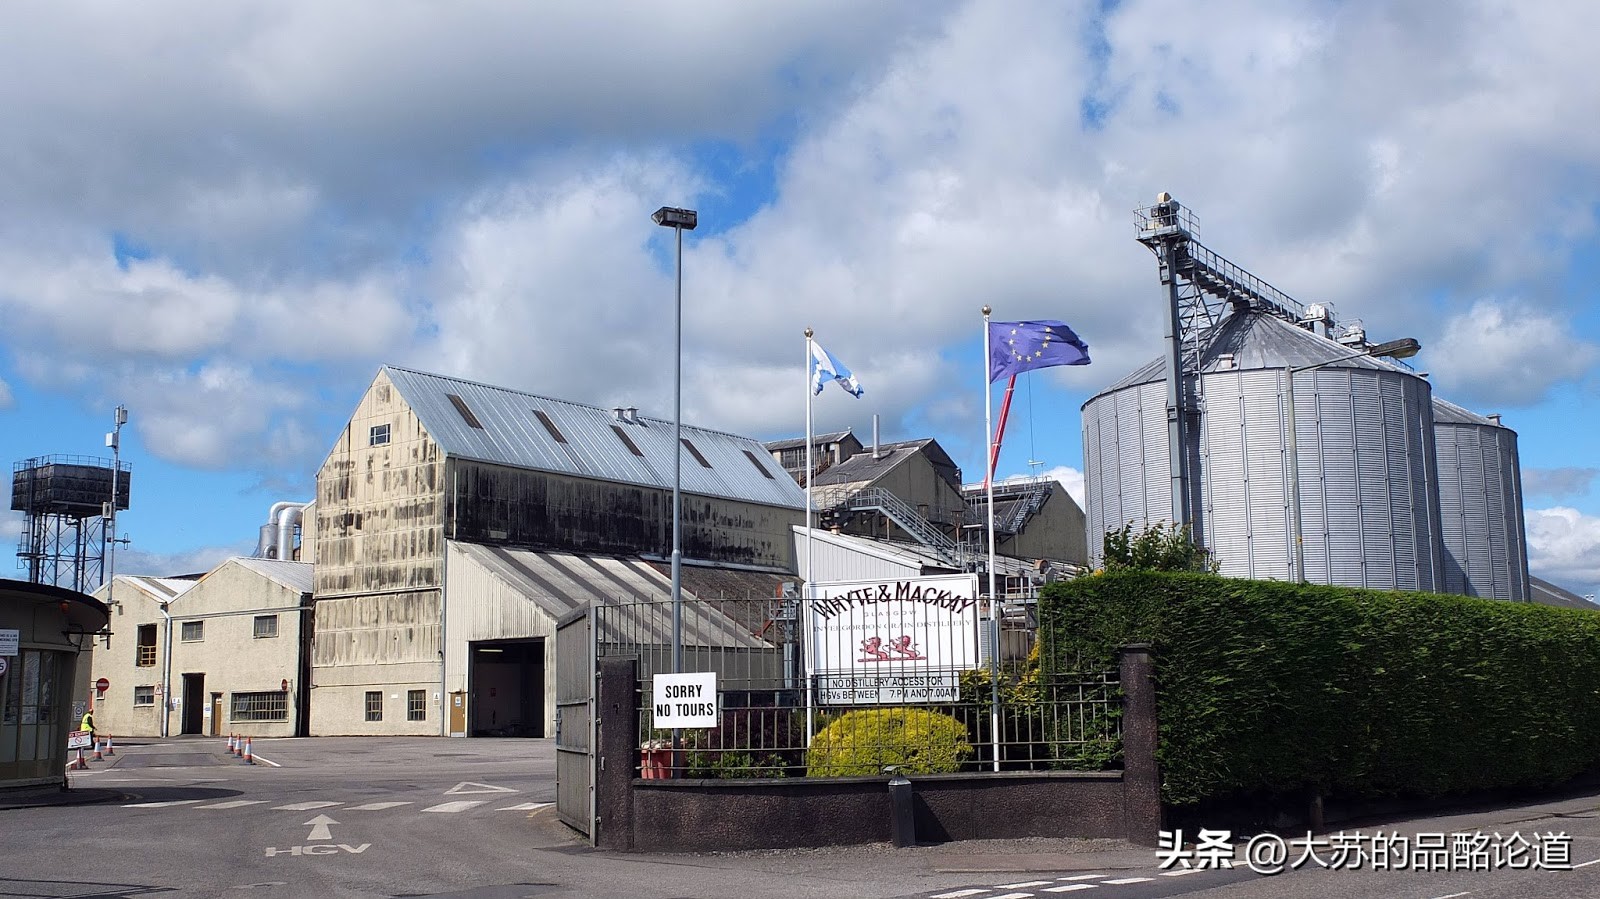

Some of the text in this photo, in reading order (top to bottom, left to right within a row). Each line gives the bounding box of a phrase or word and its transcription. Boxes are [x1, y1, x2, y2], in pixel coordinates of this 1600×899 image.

[809, 588, 877, 620] WHYTE
[895, 581, 976, 614] MACKAY
[916, 619, 971, 628] DSTLLERY
[832, 679, 844, 688] NO
[845, 677, 889, 688] DSTILLERY
[892, 676, 925, 686] ACCESS
[665, 684, 702, 698] SORRY
[820, 690, 841, 700] HGVs
[842, 690, 879, 699] BETWEEN
[910, 688, 928, 698] AND
[656, 702, 714, 717] NO TOURS
[265, 843, 372, 857] HGV
